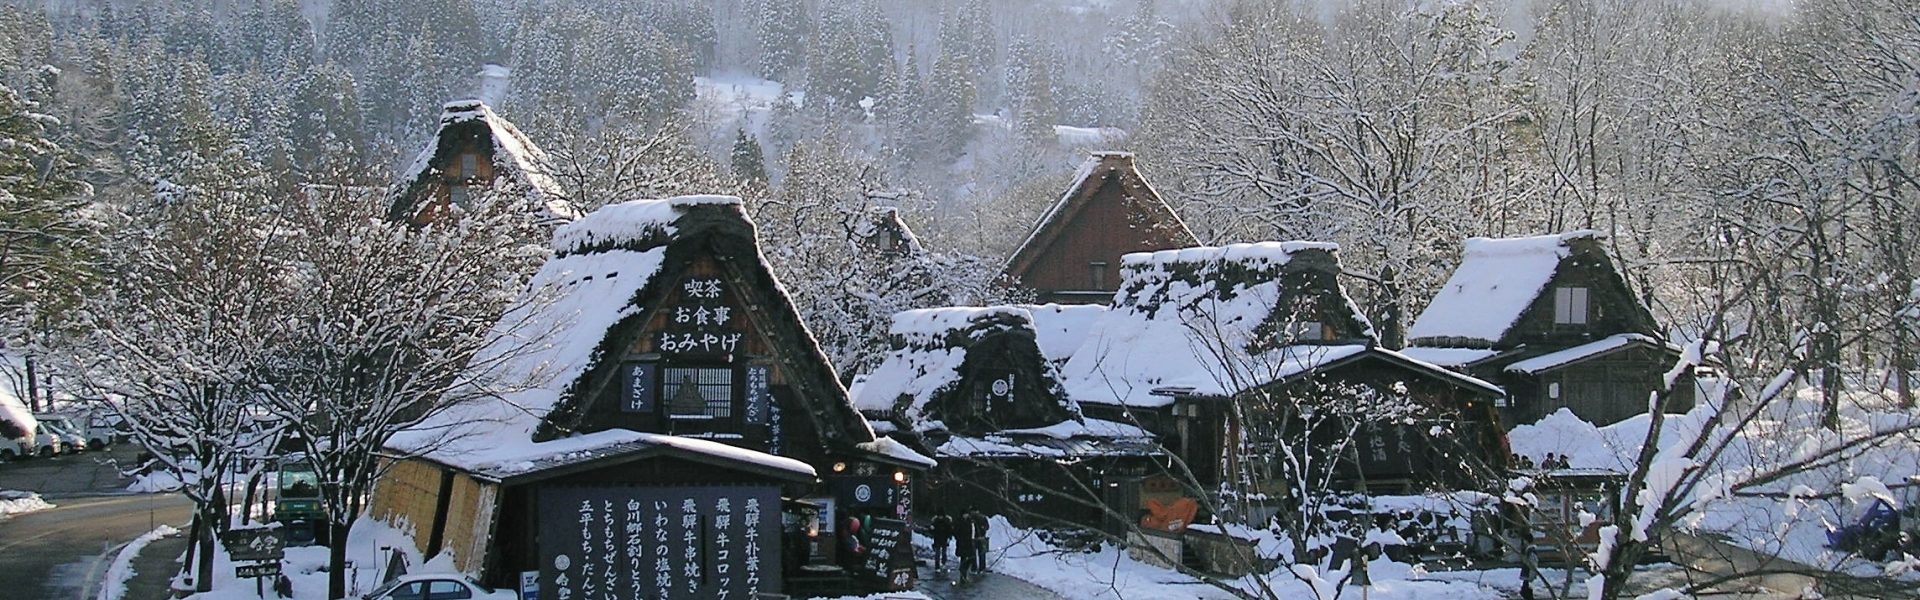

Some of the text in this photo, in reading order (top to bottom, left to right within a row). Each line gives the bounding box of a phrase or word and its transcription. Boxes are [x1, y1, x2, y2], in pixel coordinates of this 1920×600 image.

[684, 278, 723, 299] 喫茶
[675, 305, 731, 326] お食事
[660, 332, 741, 353] おみやげ
[631, 366, 644, 410] あまざけ
[682, 499, 700, 593] 飛騨牛串焼き
[715, 498, 731, 600] 飛騨牛コロッケ
